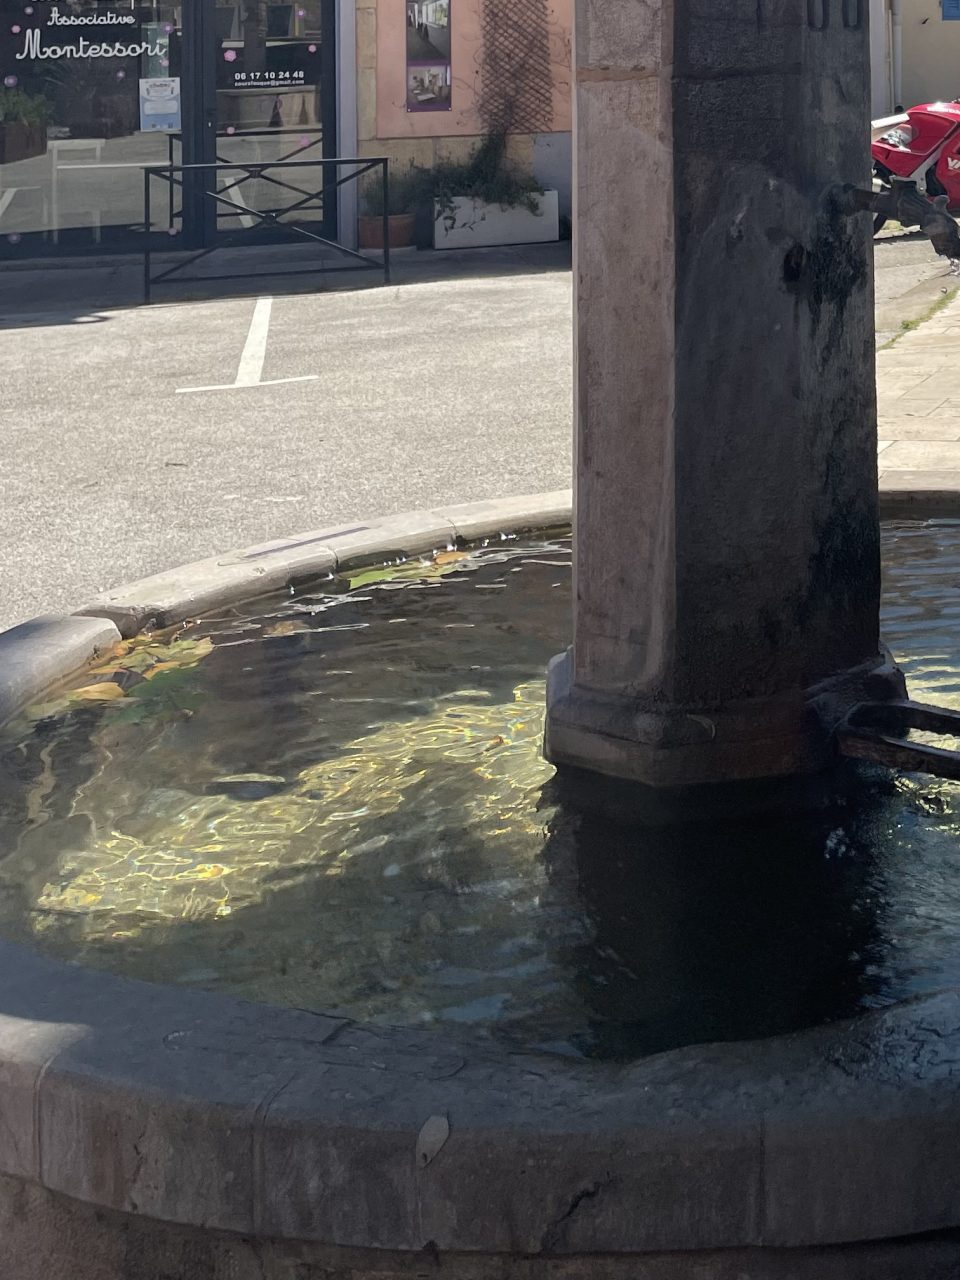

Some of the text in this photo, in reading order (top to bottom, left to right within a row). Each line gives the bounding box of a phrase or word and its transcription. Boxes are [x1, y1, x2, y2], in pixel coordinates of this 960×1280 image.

[47, 7, 135, 25] Associative
[16, 28, 167, 59] Montessori
[234, 70, 304, 80] 06 17 10 24 48
